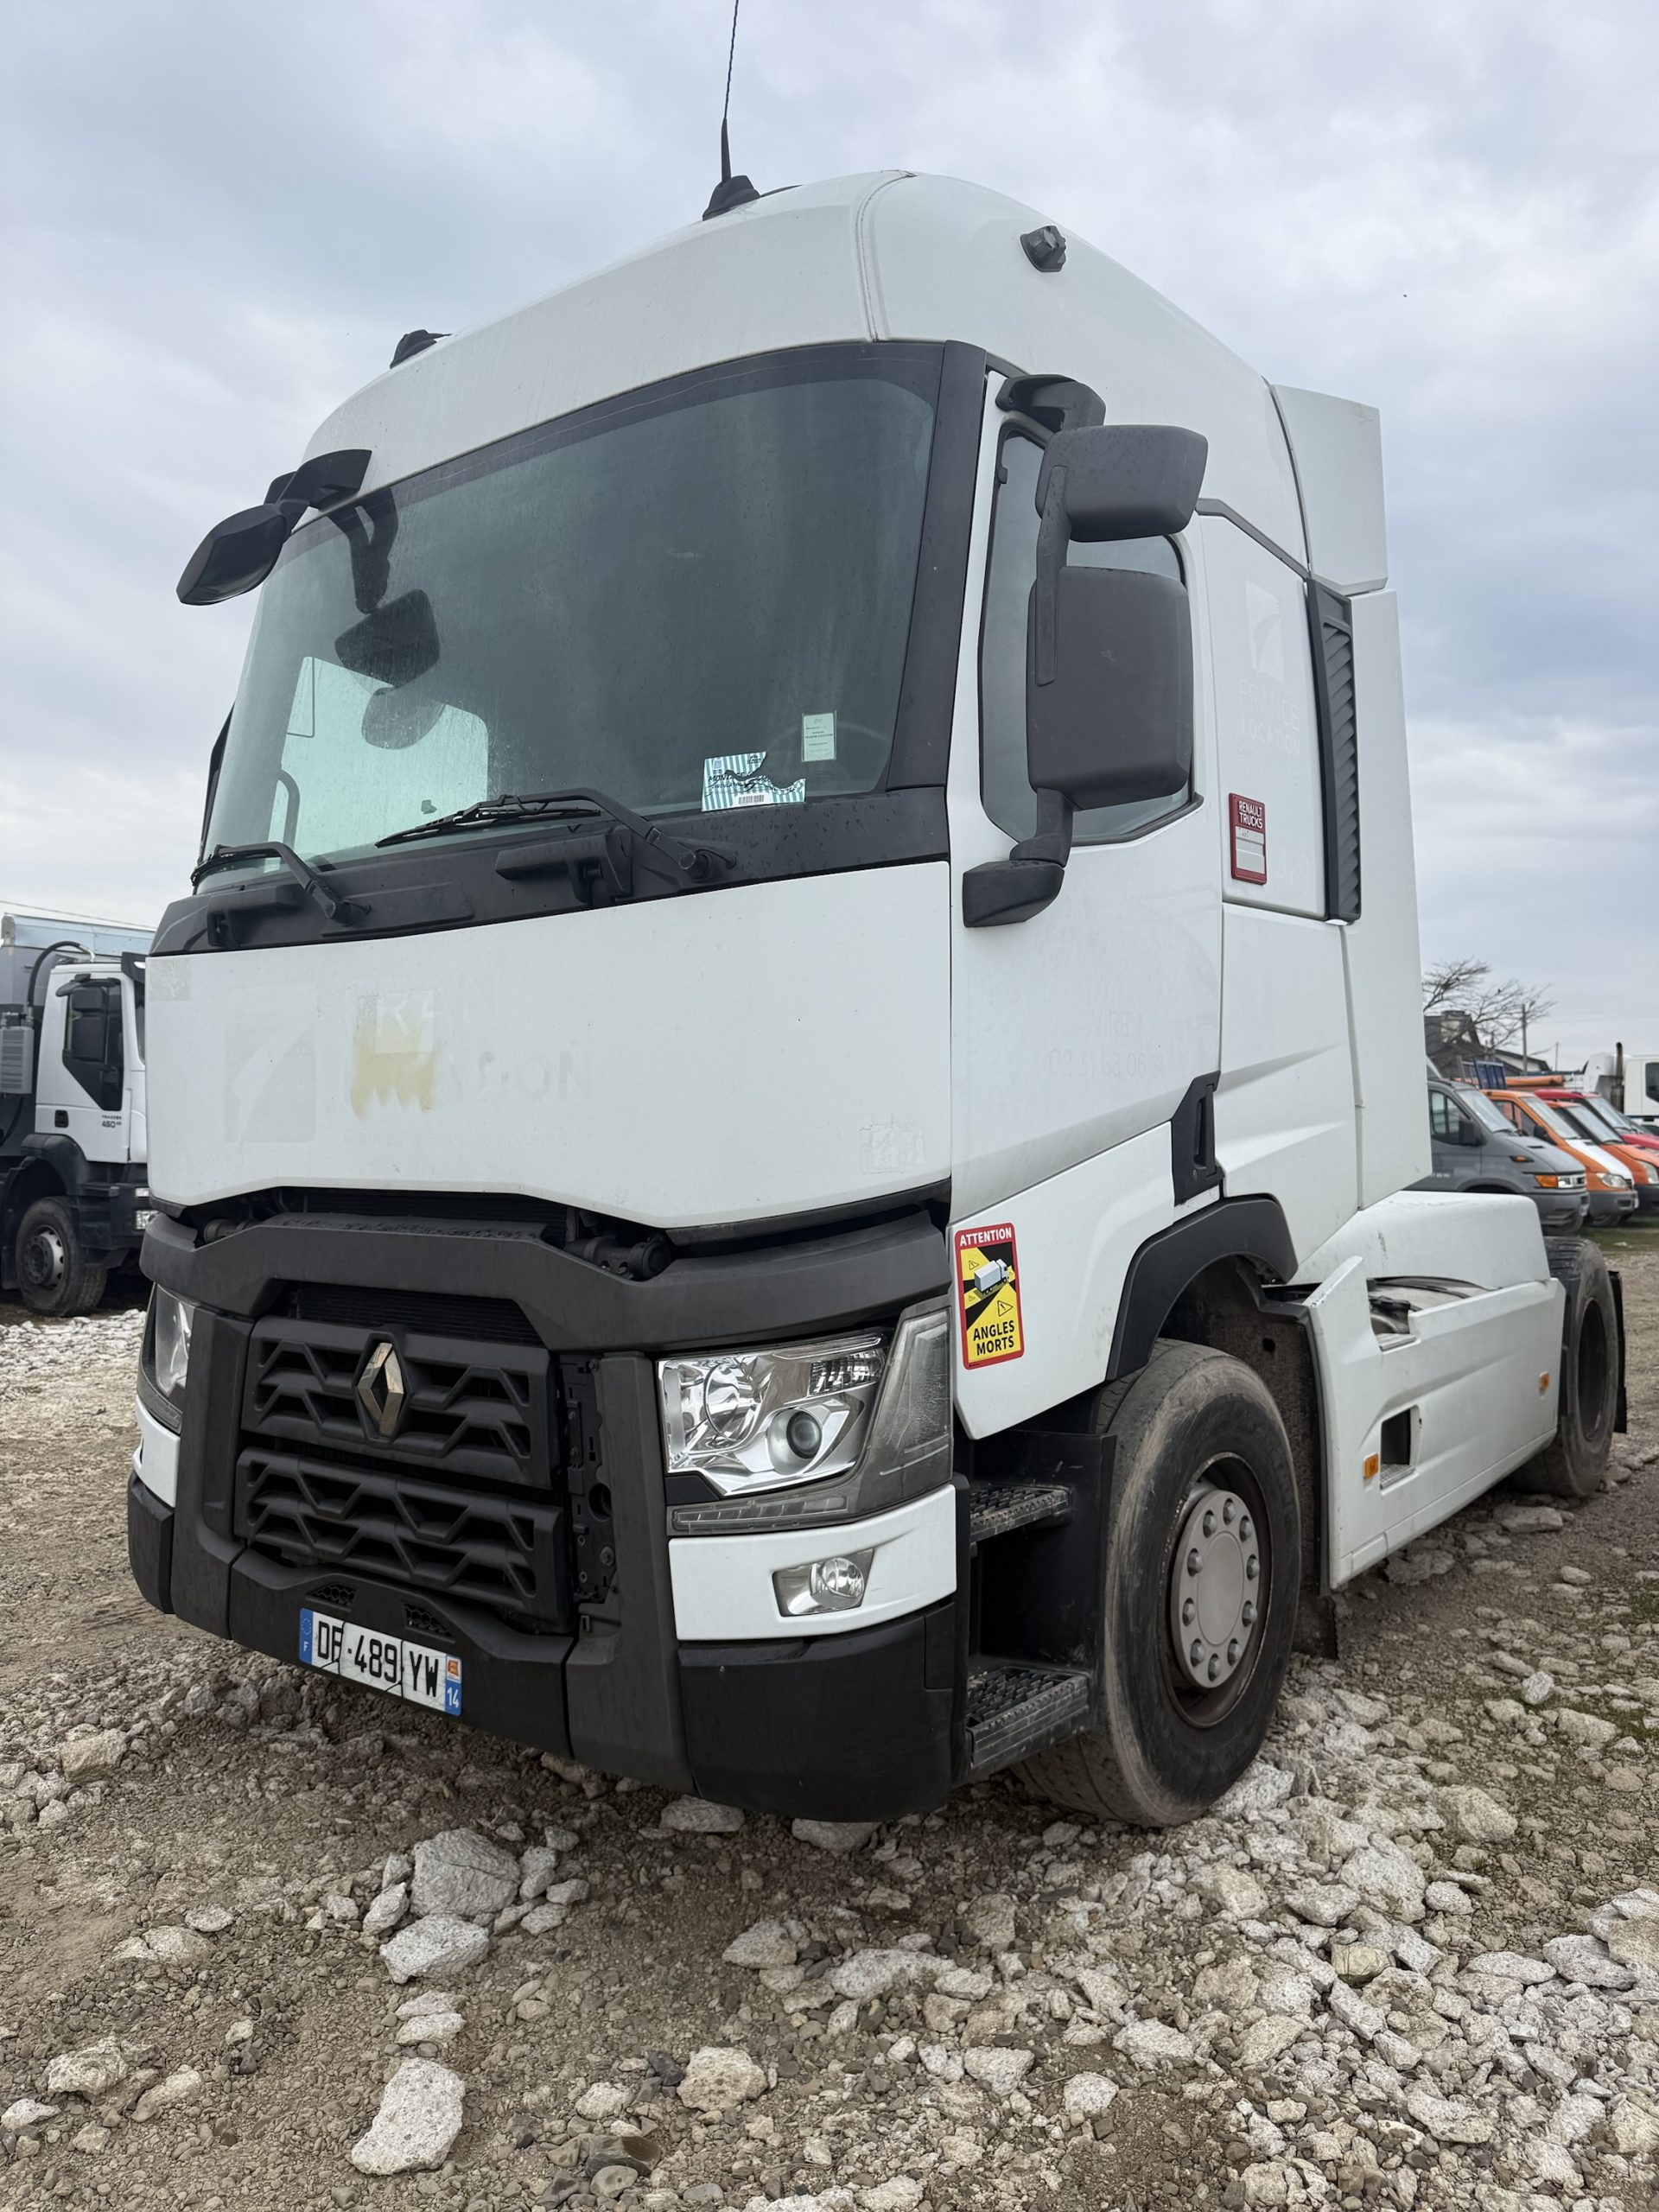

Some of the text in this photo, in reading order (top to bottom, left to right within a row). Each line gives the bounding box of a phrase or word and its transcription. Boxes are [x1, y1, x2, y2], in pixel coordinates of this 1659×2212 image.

[1239, 800, 1262, 817] RENAULT
[1239, 812, 1263, 830] TRUCKS
[959, 1227, 1013, 1247] ATTENTION
[973, 1319, 1015, 1342] ANGLES
[976, 1335, 1015, 1356] MORTS
[303, 1641, 309, 1651] F
[447, 1687, 460, 1708] 14
